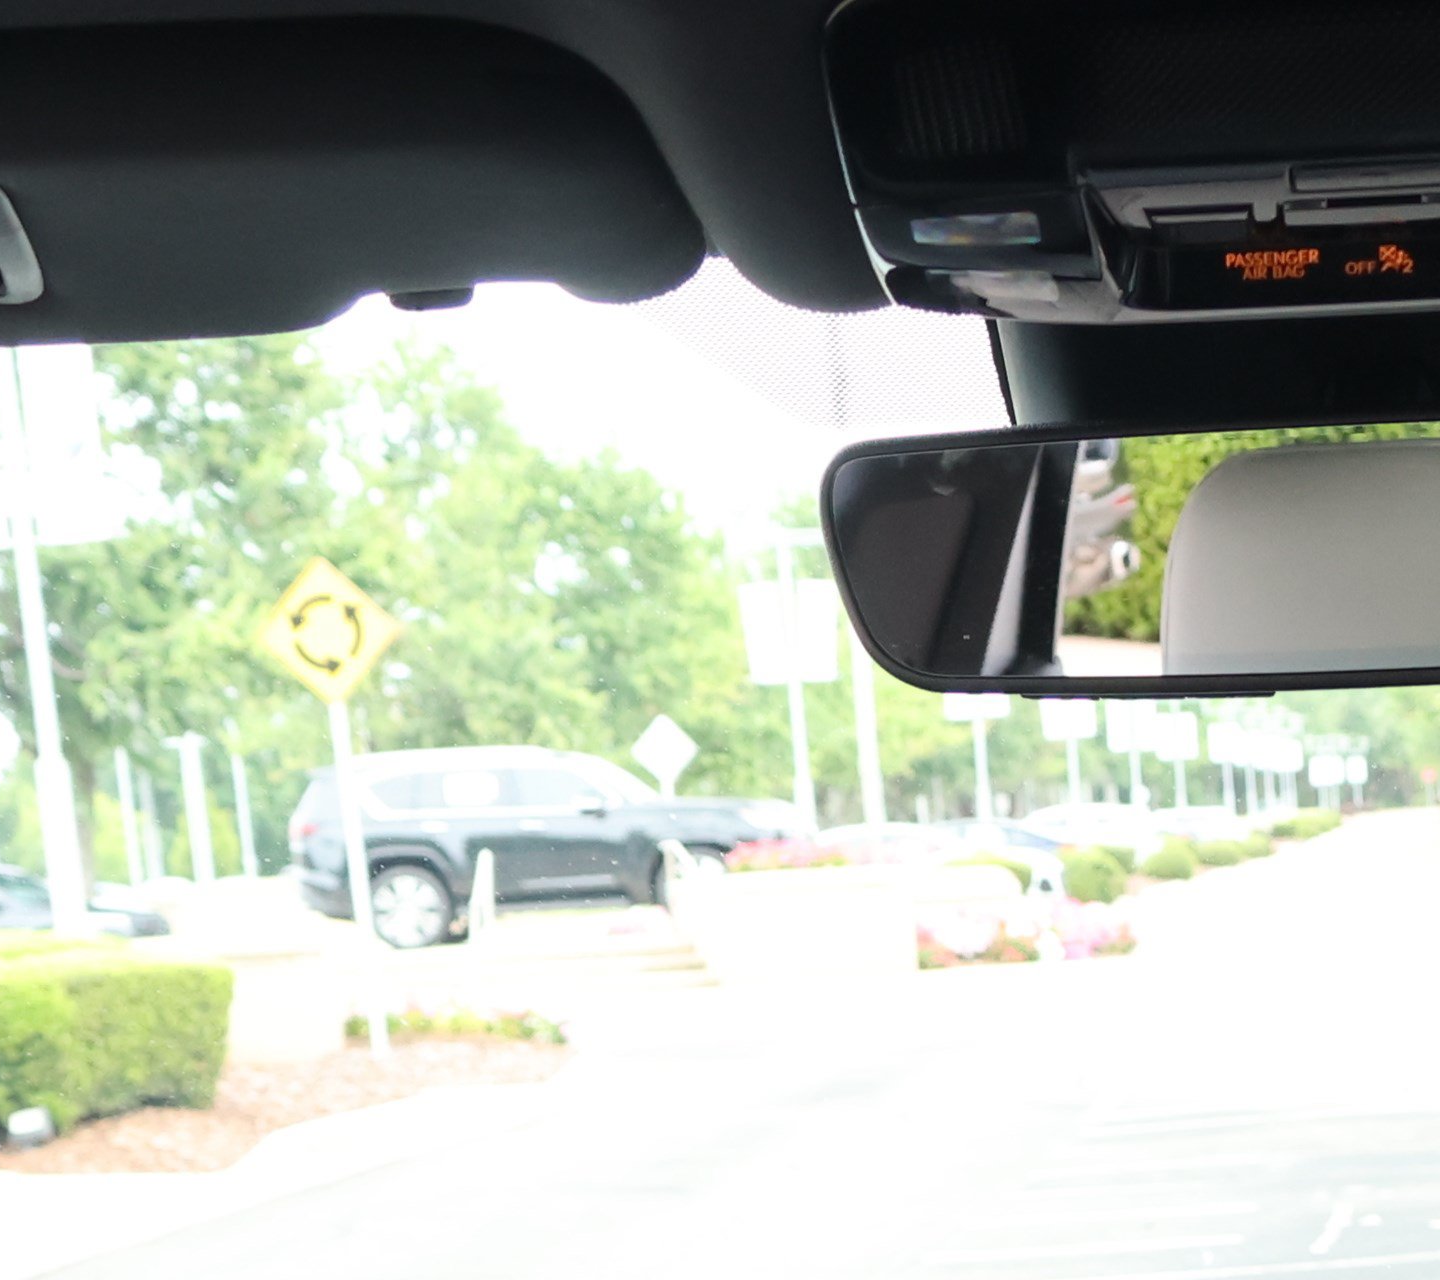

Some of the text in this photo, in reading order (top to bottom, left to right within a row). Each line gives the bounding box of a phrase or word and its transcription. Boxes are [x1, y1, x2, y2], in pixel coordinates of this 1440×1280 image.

[1225, 248, 1320, 268] PASSENGER
[1243, 265, 1305, 280] AIR BAG
[1344, 260, 1378, 276] OFF
